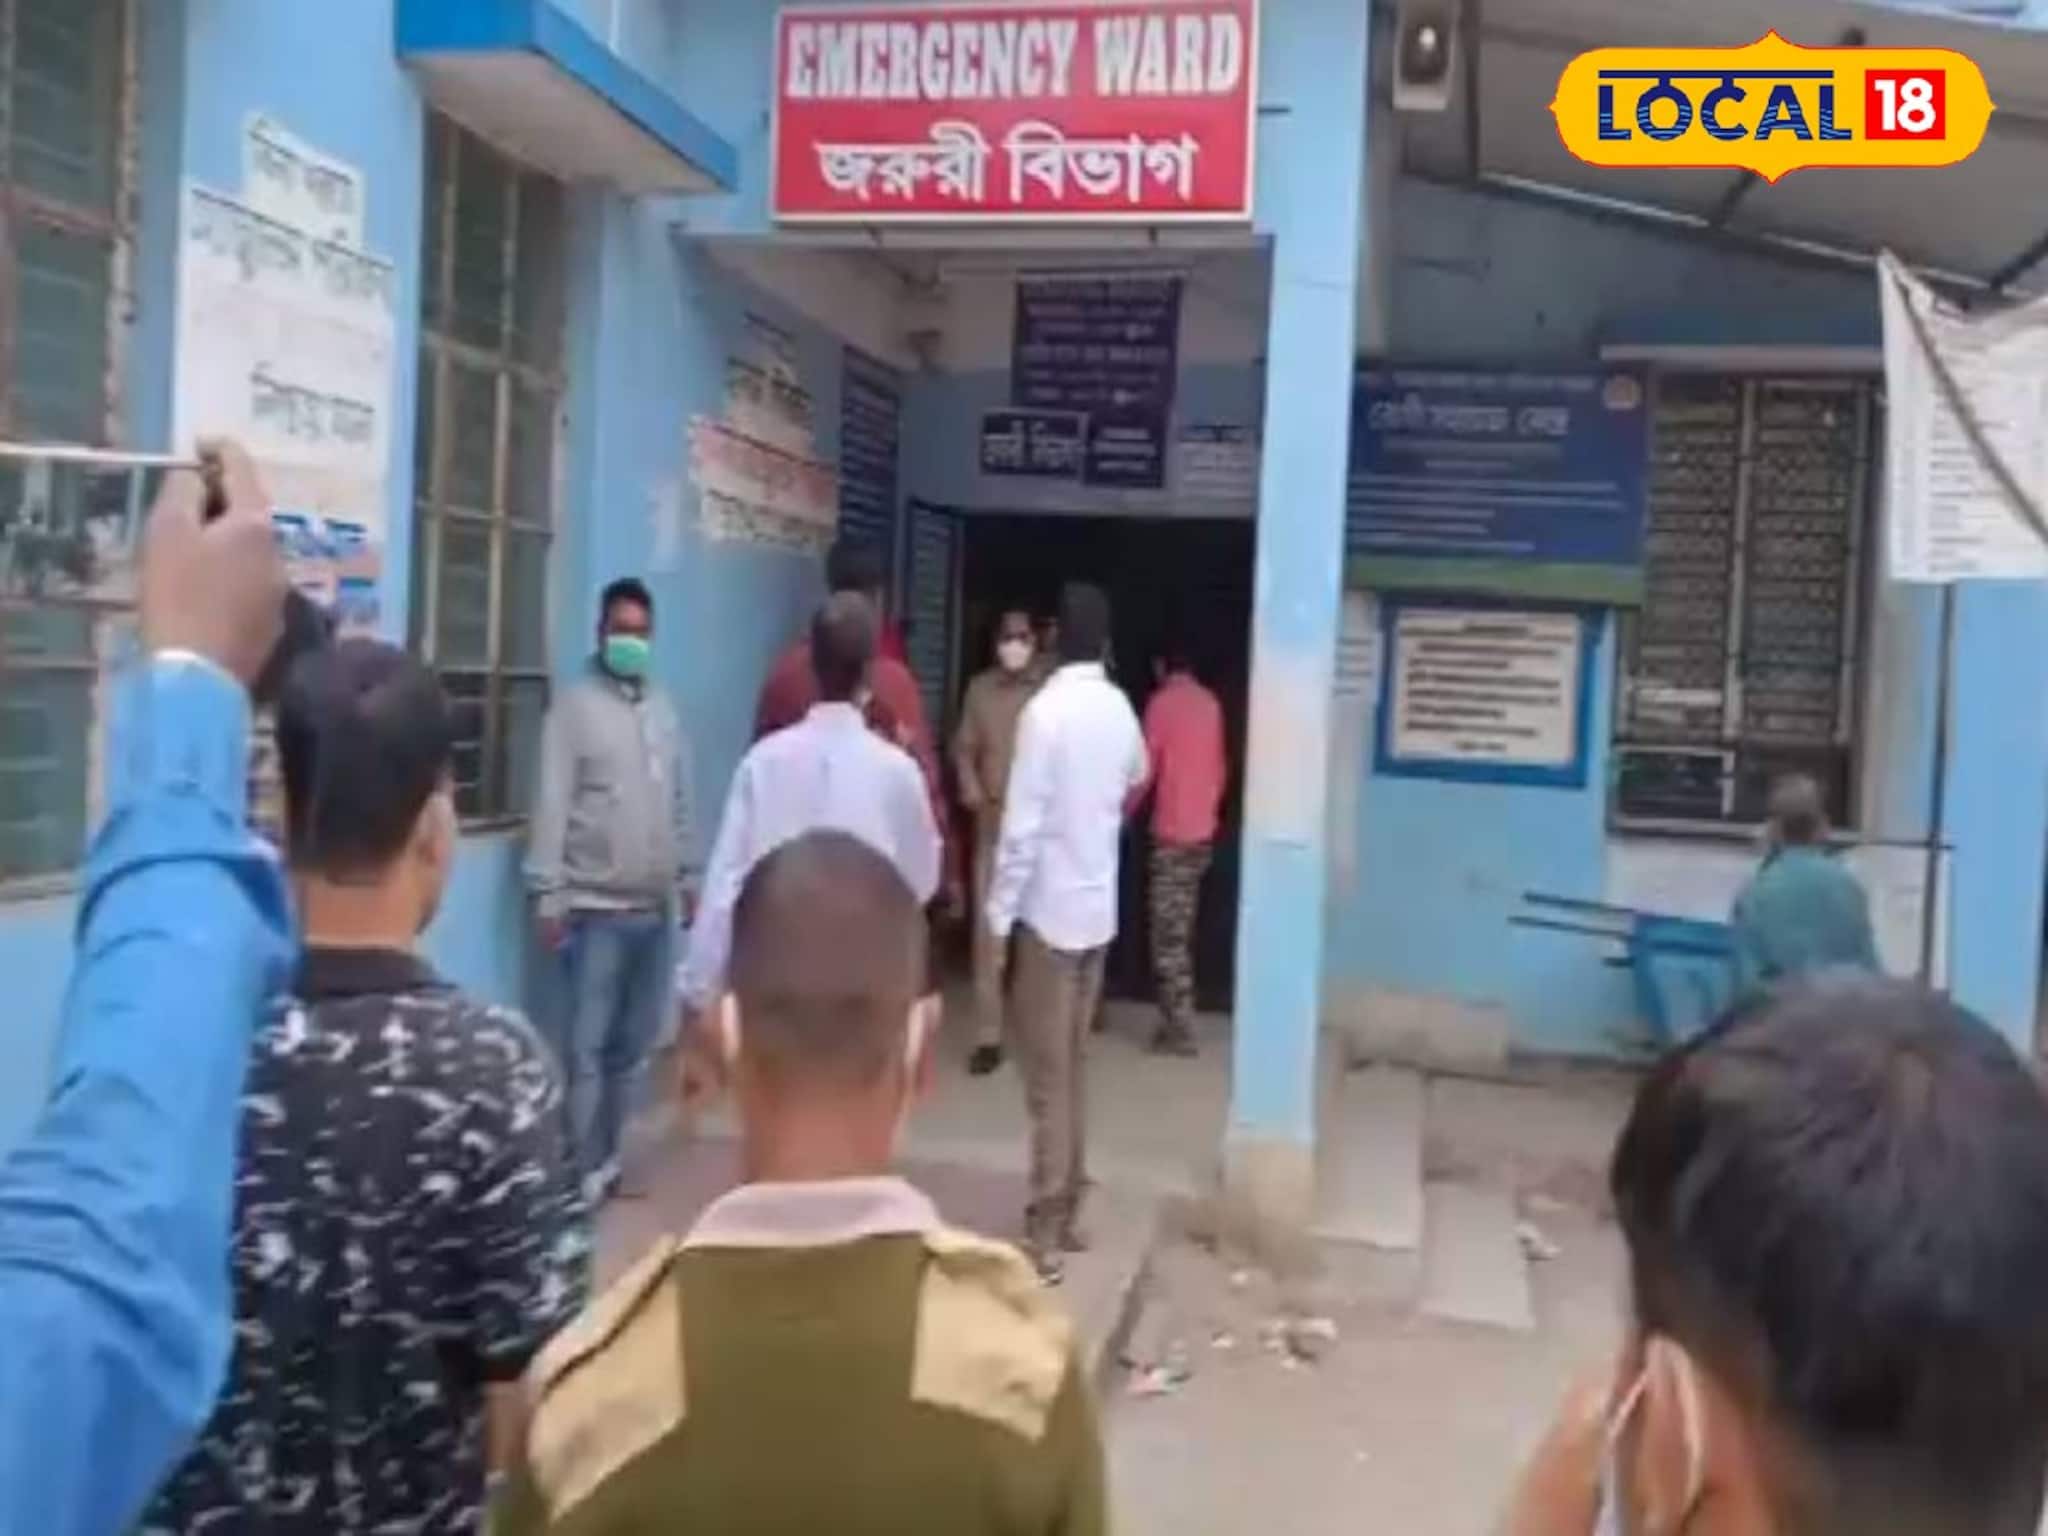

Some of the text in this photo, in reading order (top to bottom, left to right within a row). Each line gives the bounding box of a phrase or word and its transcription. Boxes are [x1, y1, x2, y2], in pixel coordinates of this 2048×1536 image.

[786, 13, 1242, 99] EMERGENCY WARD
[813, 120, 1199, 203] জরুরী বিভাগ
